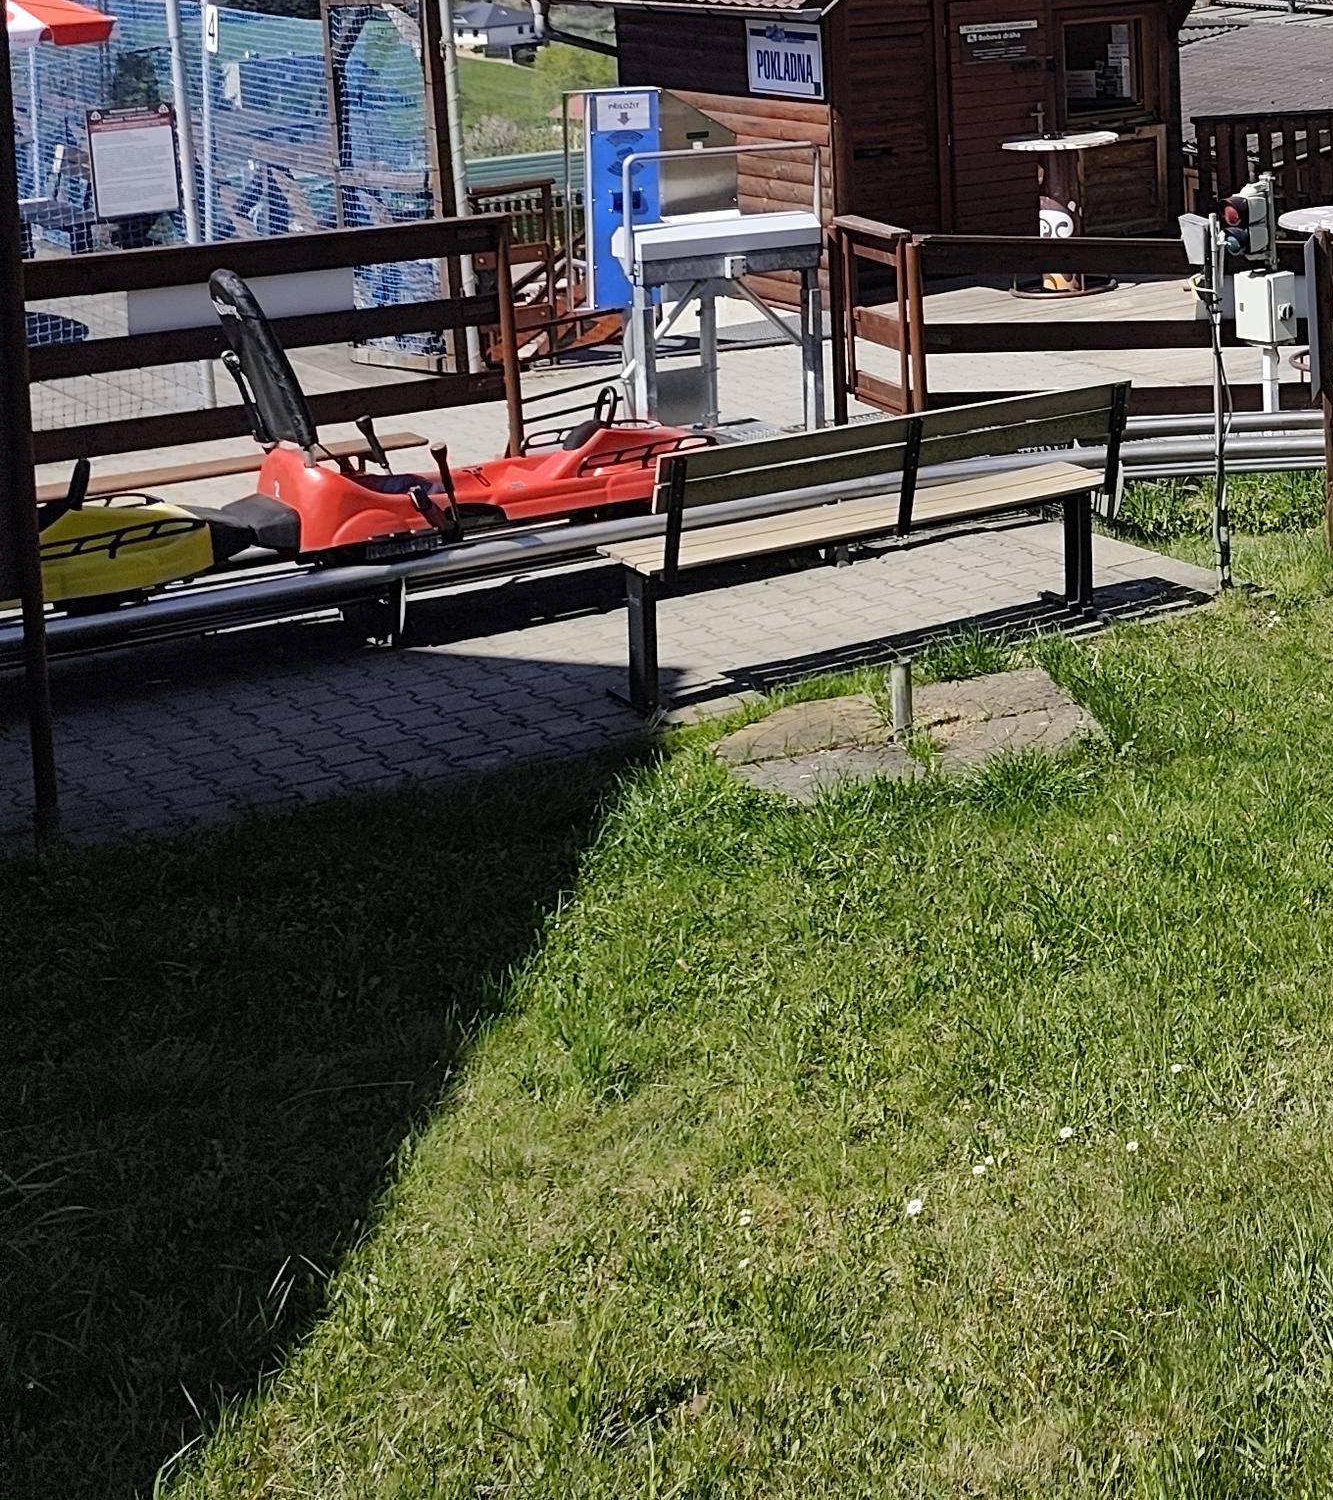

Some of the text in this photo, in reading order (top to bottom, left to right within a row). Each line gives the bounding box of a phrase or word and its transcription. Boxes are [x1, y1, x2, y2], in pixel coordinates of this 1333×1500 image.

[208, 11, 215, 45] 4
[756, 49, 814, 84] POKLADNA
[608, 102, 640, 110] PŘILOŽIT
[273, 480, 281, 498] 2
